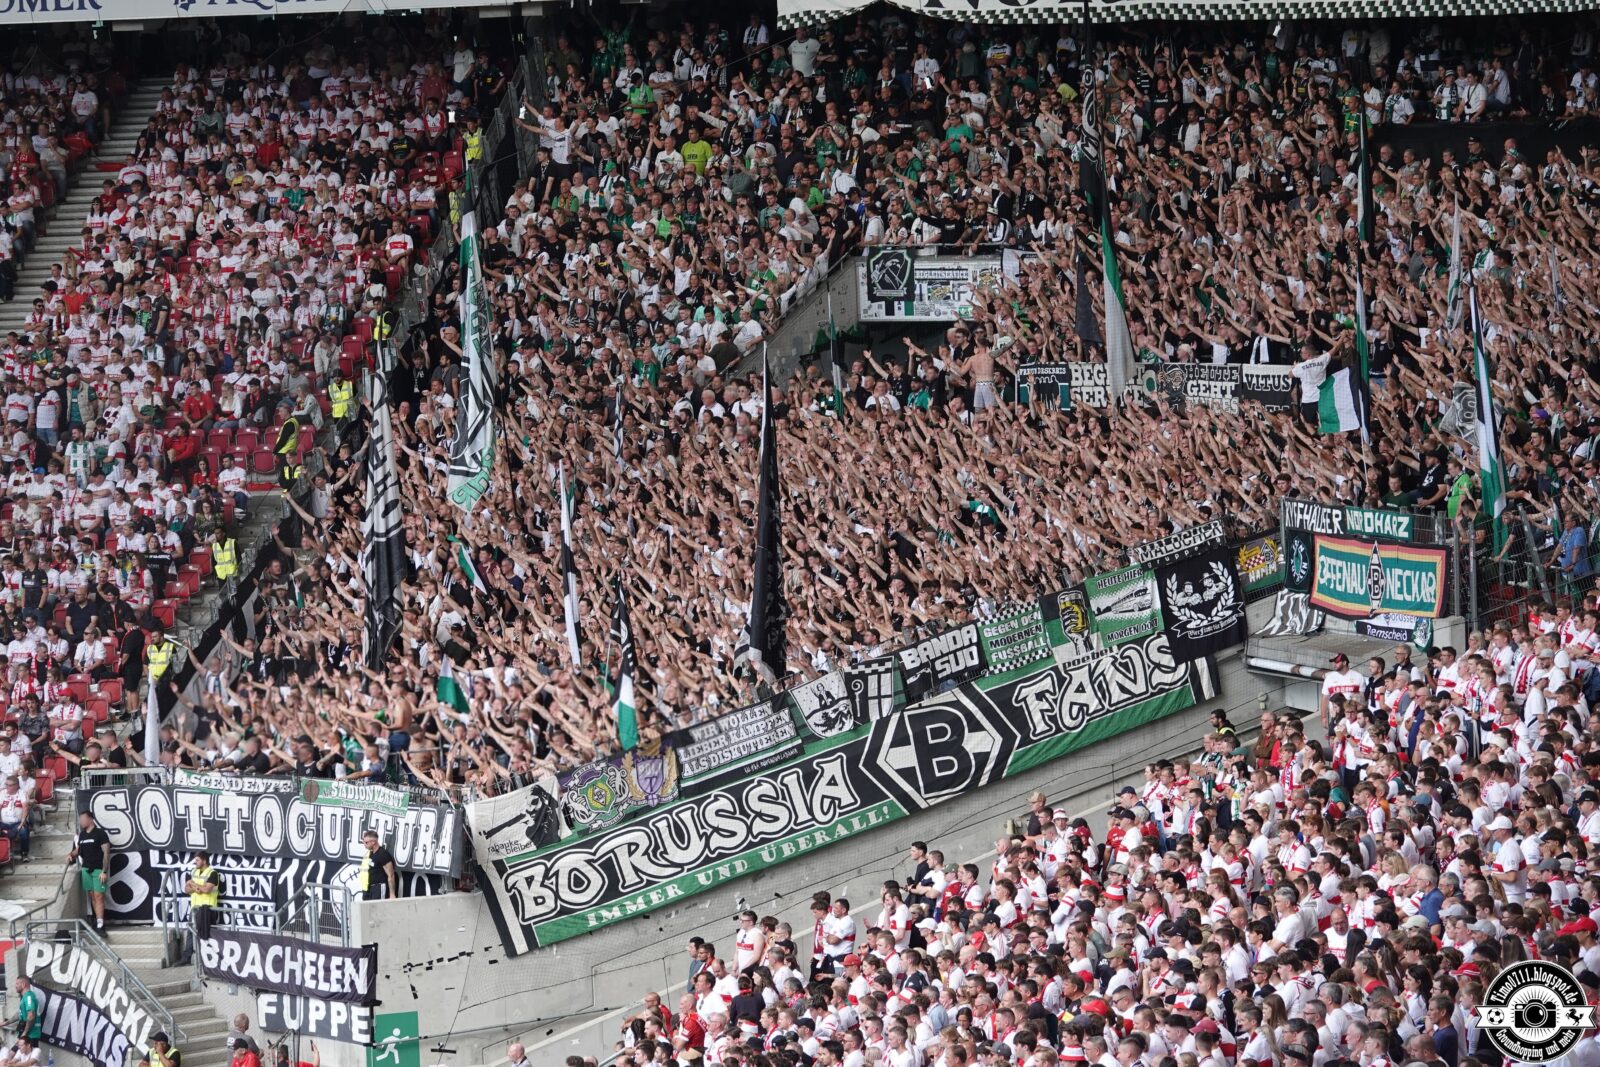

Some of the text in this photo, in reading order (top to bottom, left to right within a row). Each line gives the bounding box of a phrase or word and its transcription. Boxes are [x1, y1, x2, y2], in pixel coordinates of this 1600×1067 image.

[1185, 364, 1240, 384] HEUTE
[1244, 373, 1292, 392] VITUS
[1186, 380, 1237, 399] GEHT
[1345, 508, 1410, 538] NORDHARZ
[1138, 524, 1223, 562] MALOCHER
[1147, 546, 1199, 568] gruppe
[1096, 568, 1144, 590] HEUTE HIER
[1385, 561, 1436, 604] NECKAR
[983, 610, 1042, 637] GEGEN DEN
[988, 624, 1043, 650] MODERNEN
[1106, 625, 1140, 643] MORGEN
[1366, 624, 1408, 641] Remscheid
[899, 623, 978, 670] BANDA
[689, 700, 775, 742] WIR WOLLEN
[677, 733, 730, 764] LIEBER
[682, 757, 709, 778] ALS
[708, 722, 797, 769] DISKUTIEREN
[174, 768, 294, 793] ASCENDENTE
[504, 752, 860, 924] BORUSSIA
[1012, 631, 1191, 740] FANS
[90, 786, 453, 873] SOTTOCULTURA
[487, 840, 519, 853] rabauke
[587, 805, 890, 927] IMMER UND ÜBERALL!
[200, 937, 369, 995] BRACHELEN
[26, 941, 153, 1057] PUMUCKL
[257, 993, 371, 1044] FUPPE
